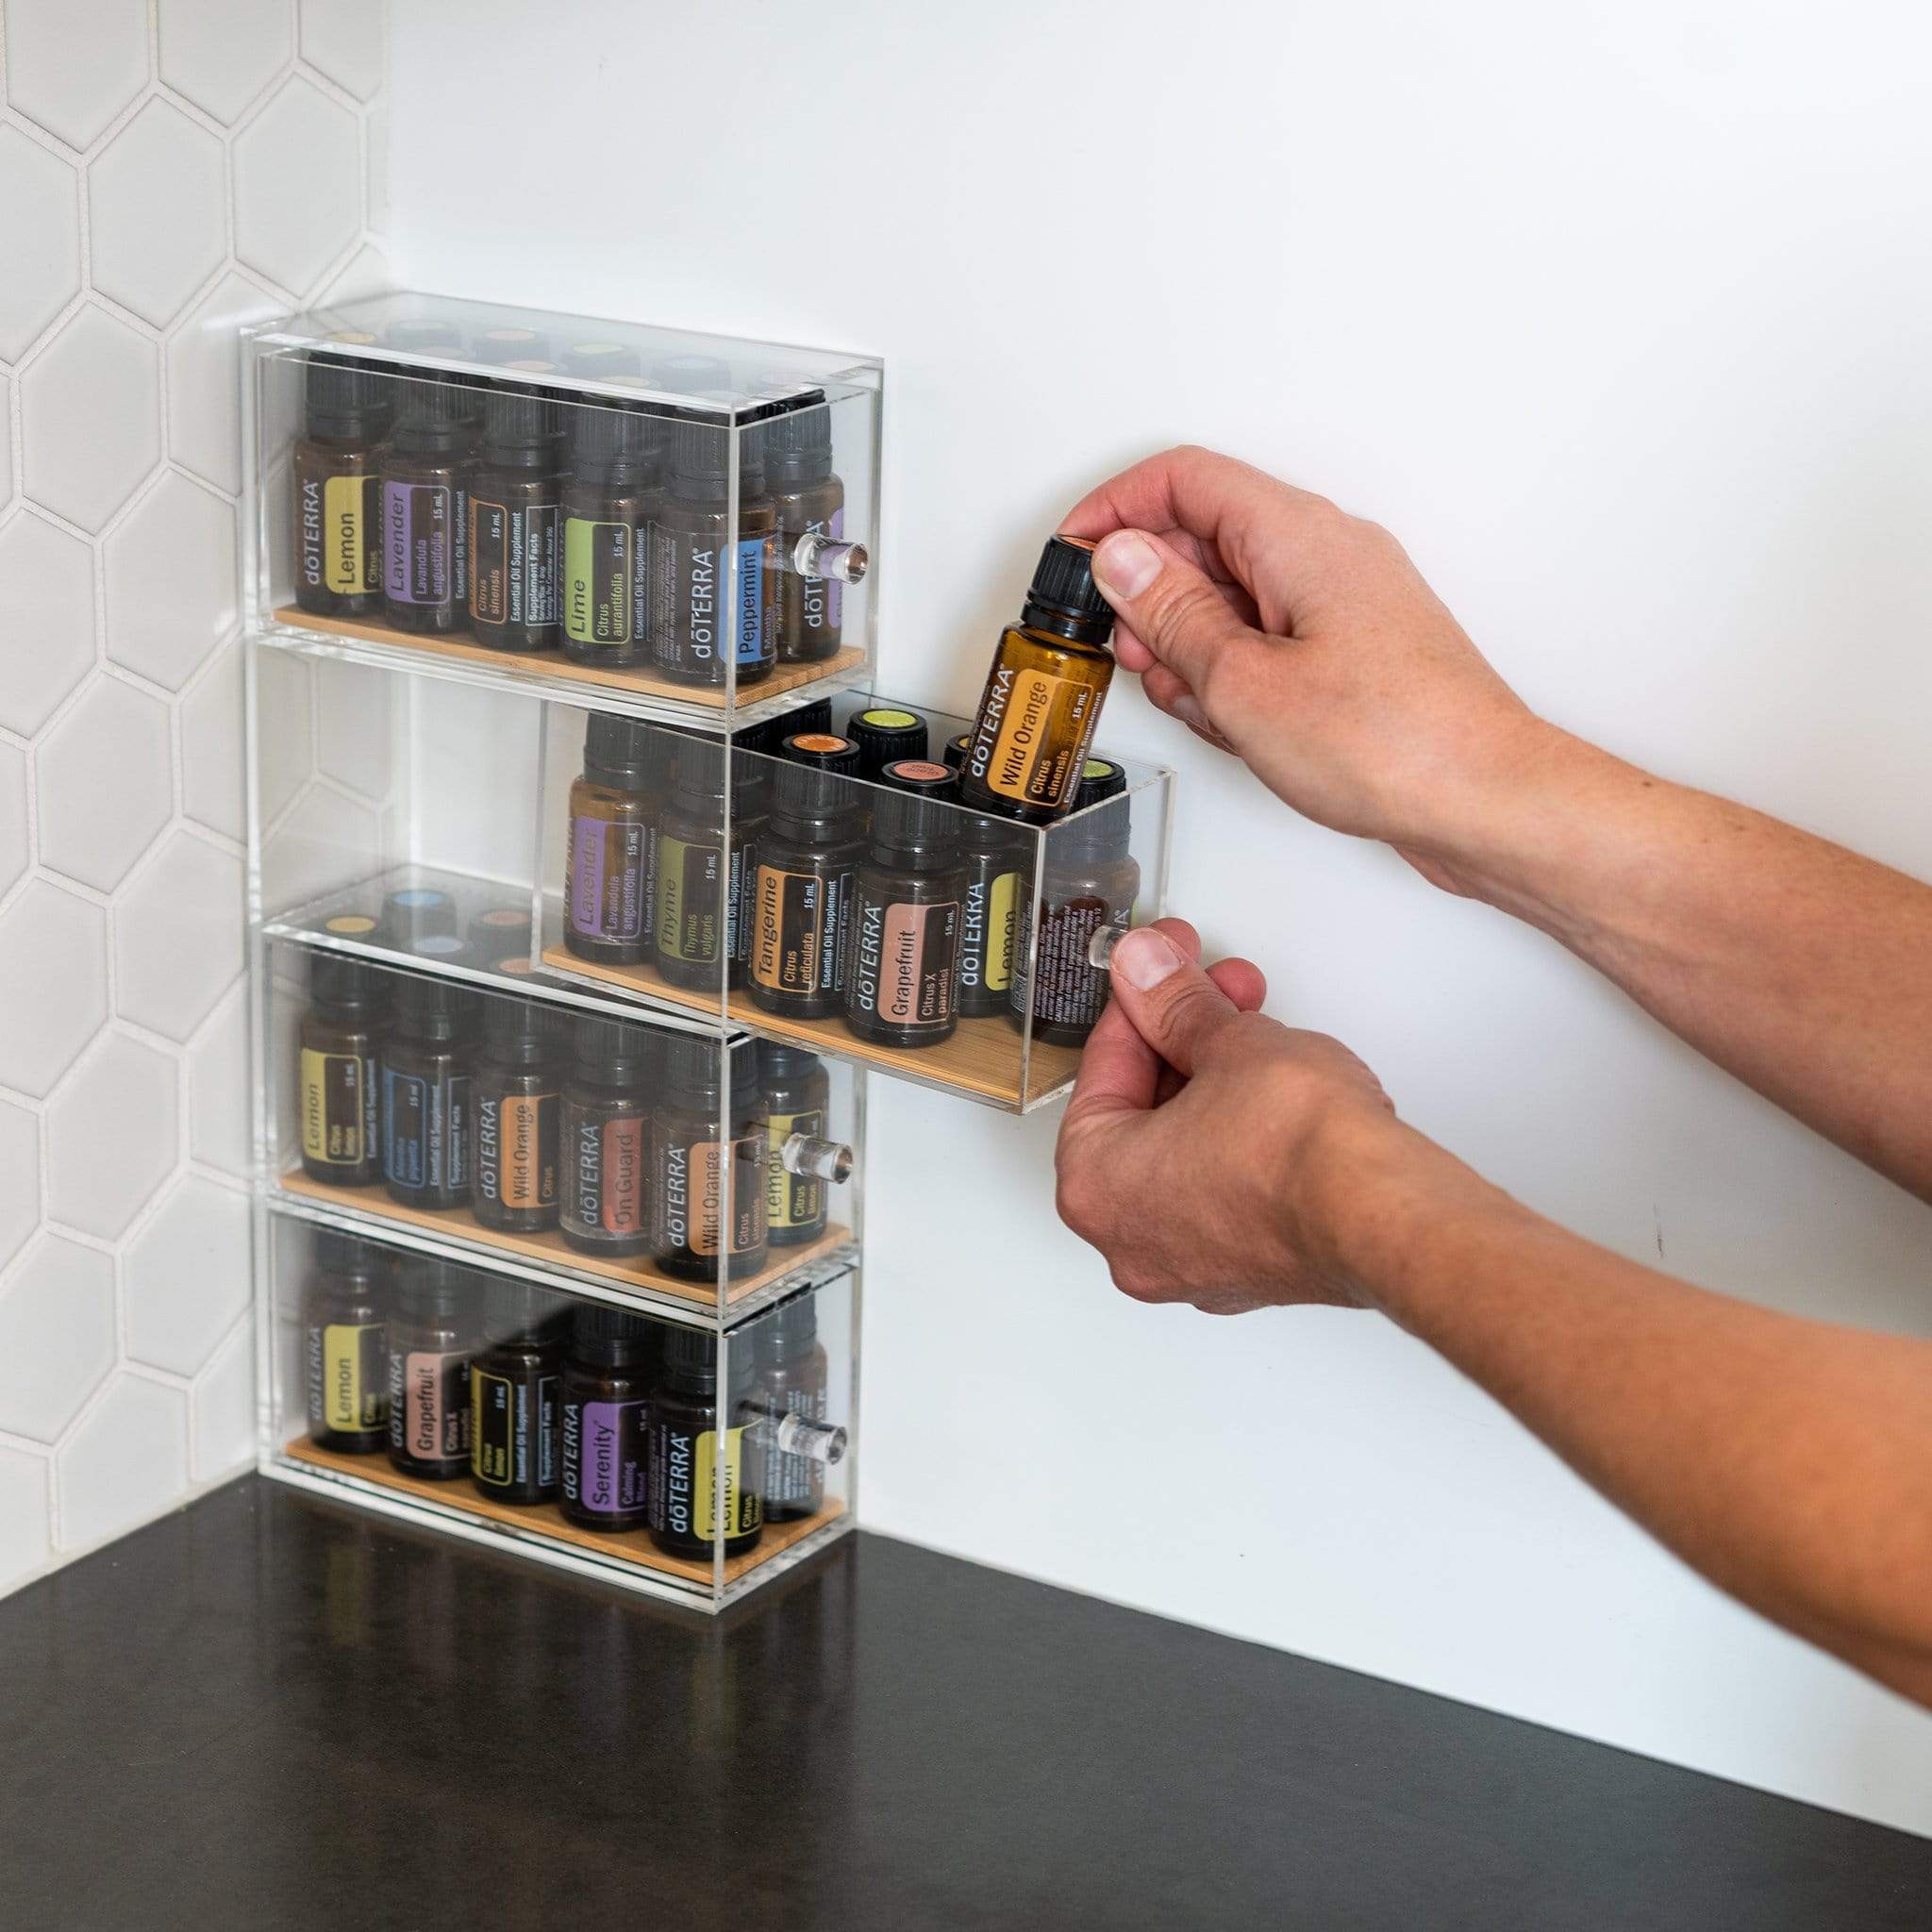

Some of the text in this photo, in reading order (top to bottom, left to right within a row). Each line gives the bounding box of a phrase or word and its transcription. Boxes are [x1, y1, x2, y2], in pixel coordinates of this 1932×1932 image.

[391, 492, 405, 592] Lavender
[433, 508, 443, 520] 15
[456, 490, 466, 599] Essential Oil Supplement
[491, 527, 500, 539] 15
[338, 512, 355, 585] Lemon
[367, 550, 379, 583] Citrus
[416, 539, 427, 595] Lavandula
[431, 531, 445, 595] angustifolia
[510, 512, 522, 622] Essential Oil Supplement
[528, 533, 540, 621] Supplement Facts
[614, 546, 624, 558] 15
[477, 578, 488, 611] Citrus
[490, 569, 500, 614] sinensis
[571, 579, 585, 634] Lime
[611, 573, 623, 637] aurantifolia
[634, 528, 645, 639] Essential Oil Supplement
[738, 551, 759, 654] Peppermint
[597, 604, 609, 636] Citrus
[1000, 681, 1047, 787] Wild Orange
[1073, 707, 1082, 719] 15
[1031, 759, 1051, 794] Citrus
[1048, 750, 1069, 797] sinensis
[1064, 691, 1103, 804] Essential Oil Supplement
[578, 827, 597, 925] Lavender
[627, 845, 638, 857] 15
[706, 870, 716, 881] 15
[606, 875, 620, 930] Lavandula
[623, 868, 638, 930] angustifolia
[660, 878, 677, 947] Thyme
[725, 851, 741, 958] Essential Oil Supplement
[758, 876, 777, 975] Tangerine
[804, 883, 814, 908] 15 mL
[683, 913, 697, 955] Thymus
[701, 913, 714, 956] vulgaris
[801, 932, 813, 984] reticulata
[822, 881, 837, 988] Essential Oil Supplement
[944, 925, 954, 937] 15
[783, 950, 796, 982] Citrus
[891, 929, 916, 1016] Grapefruit
[922, 973, 937, 1016] Citrus X
[938, 968, 950, 1014] paradisi
[308, 1084, 320, 1151] Lemon
[430, 1085, 441, 1187] Essential Oil Supplement
[451, 1105, 461, 1185] Supplement Facts
[513, 1105, 534, 1200] Wild Orange
[542, 1165, 554, 1198] Citrus
[614, 1134, 633, 1225] On Guard
[702, 1151, 723, 1249] Wild Orange
[767, 1150, 782, 1218] Lemon
[793, 1185, 806, 1216] Citrus
[738, 1213, 749, 1245] Citrus
[336, 1357, 352, 1424] Lemon
[416, 1367, 437, 1452] Grapefruit
[495, 1398, 506, 1409] 15
[515, 1385, 528, 1483] Essential Oil Supplement
[542, 1402, 553, 1481] Supplement Facts
[592, 1421, 615, 1506] Serenity
[620, 1461, 637, 1505] Calming
[741, 1494, 753, 1528] Citrus
